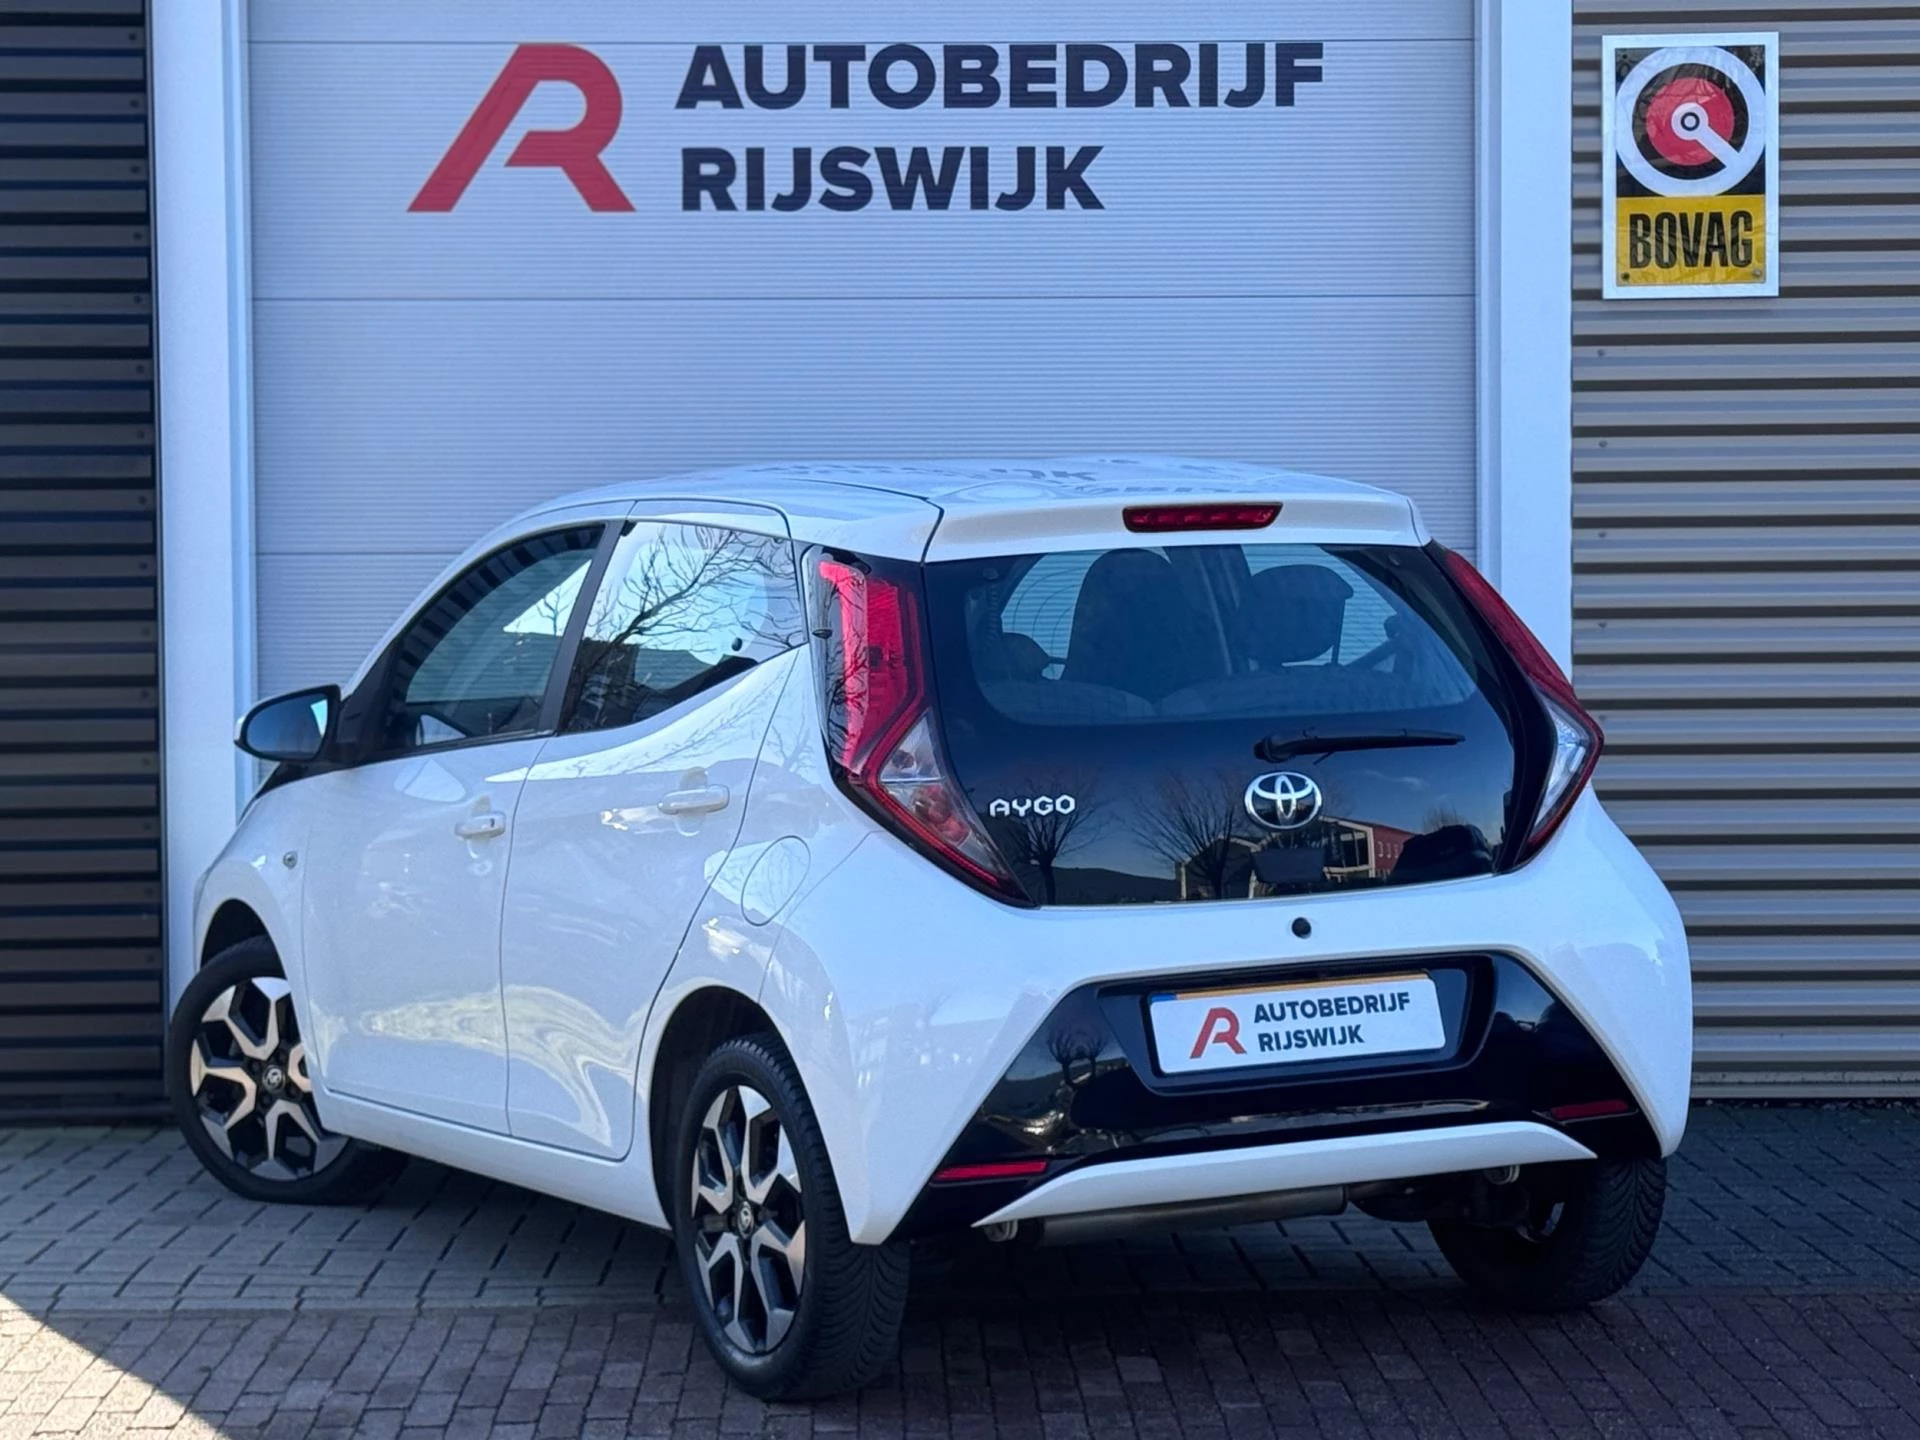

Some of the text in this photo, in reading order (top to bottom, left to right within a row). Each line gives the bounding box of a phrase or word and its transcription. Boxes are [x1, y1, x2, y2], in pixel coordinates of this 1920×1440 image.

[675, 43, 1324, 109] AUTOBEDRIJF
[681, 146, 1105, 211] RIJSWIJK
[1629, 210, 1753, 268] BOVAG
[989, 794, 1076, 817] AYGO
[1254, 992, 1410, 1023] AUTOBEDRIJF
[1258, 1024, 1364, 1052] RIJSWIJK
